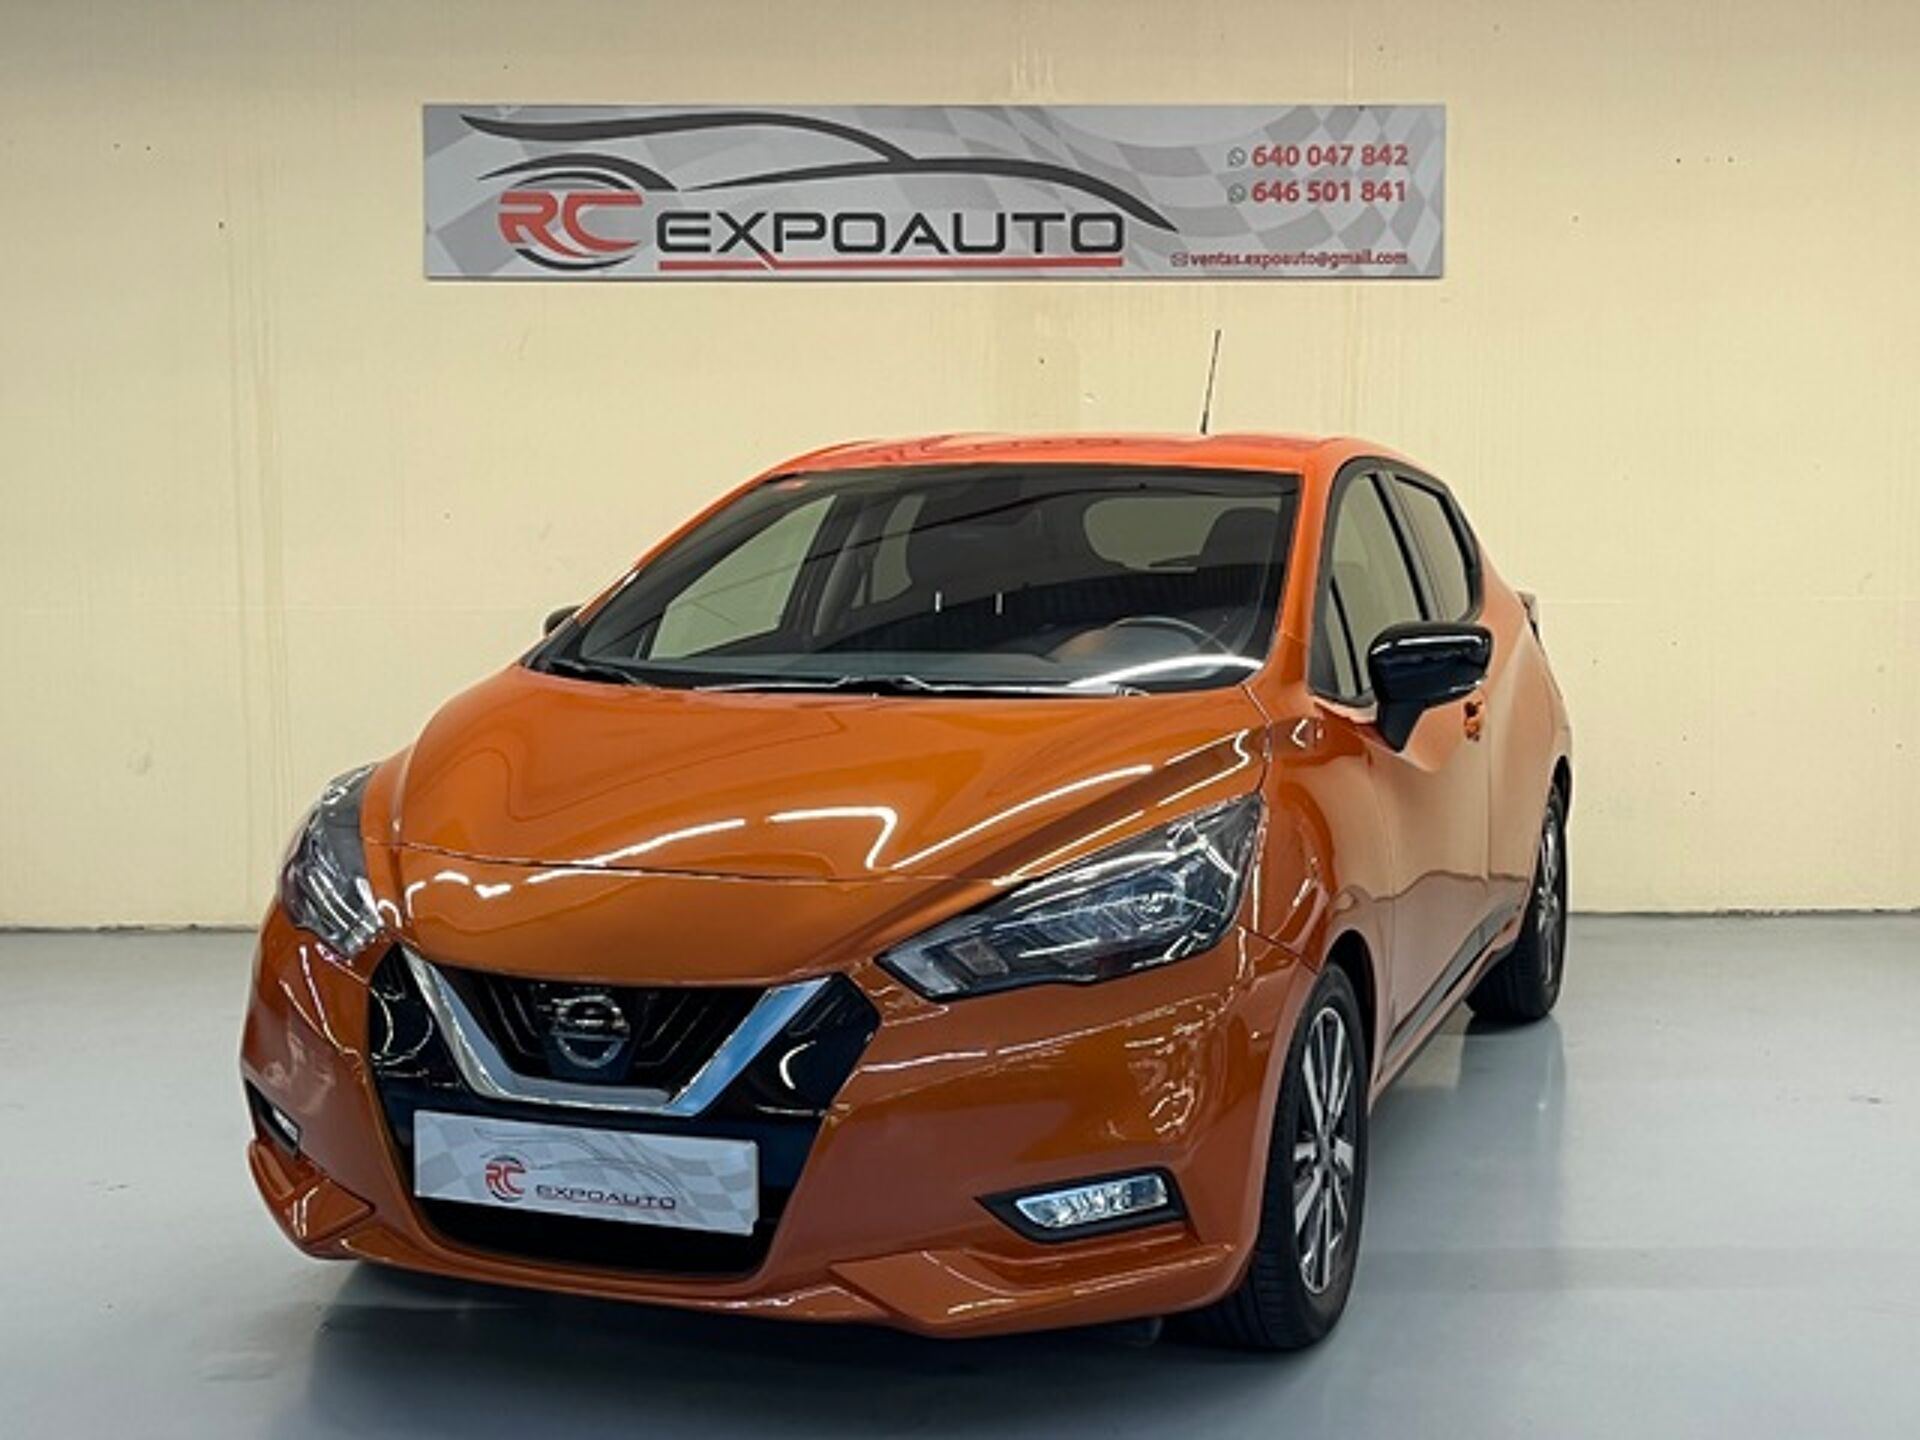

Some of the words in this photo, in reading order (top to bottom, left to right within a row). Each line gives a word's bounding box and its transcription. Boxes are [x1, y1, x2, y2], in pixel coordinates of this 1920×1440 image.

[1252, 144, 1300, 167] 640
[1307, 144, 1354, 167] 047
[1361, 144, 1409, 167] 842
[1252, 180, 1300, 203] 646
[1307, 180, 1351, 203] 501
[1361, 180, 1406, 203] 841
[498, 190, 644, 259] RC
[656, 211, 1125, 255] EXPOAUTO
[1190, 248, 1408, 269] ventas.expoauto@gmail.com
[485, 1162, 526, 1196] RC
[535, 1184, 677, 1210] EXPOAUTO
